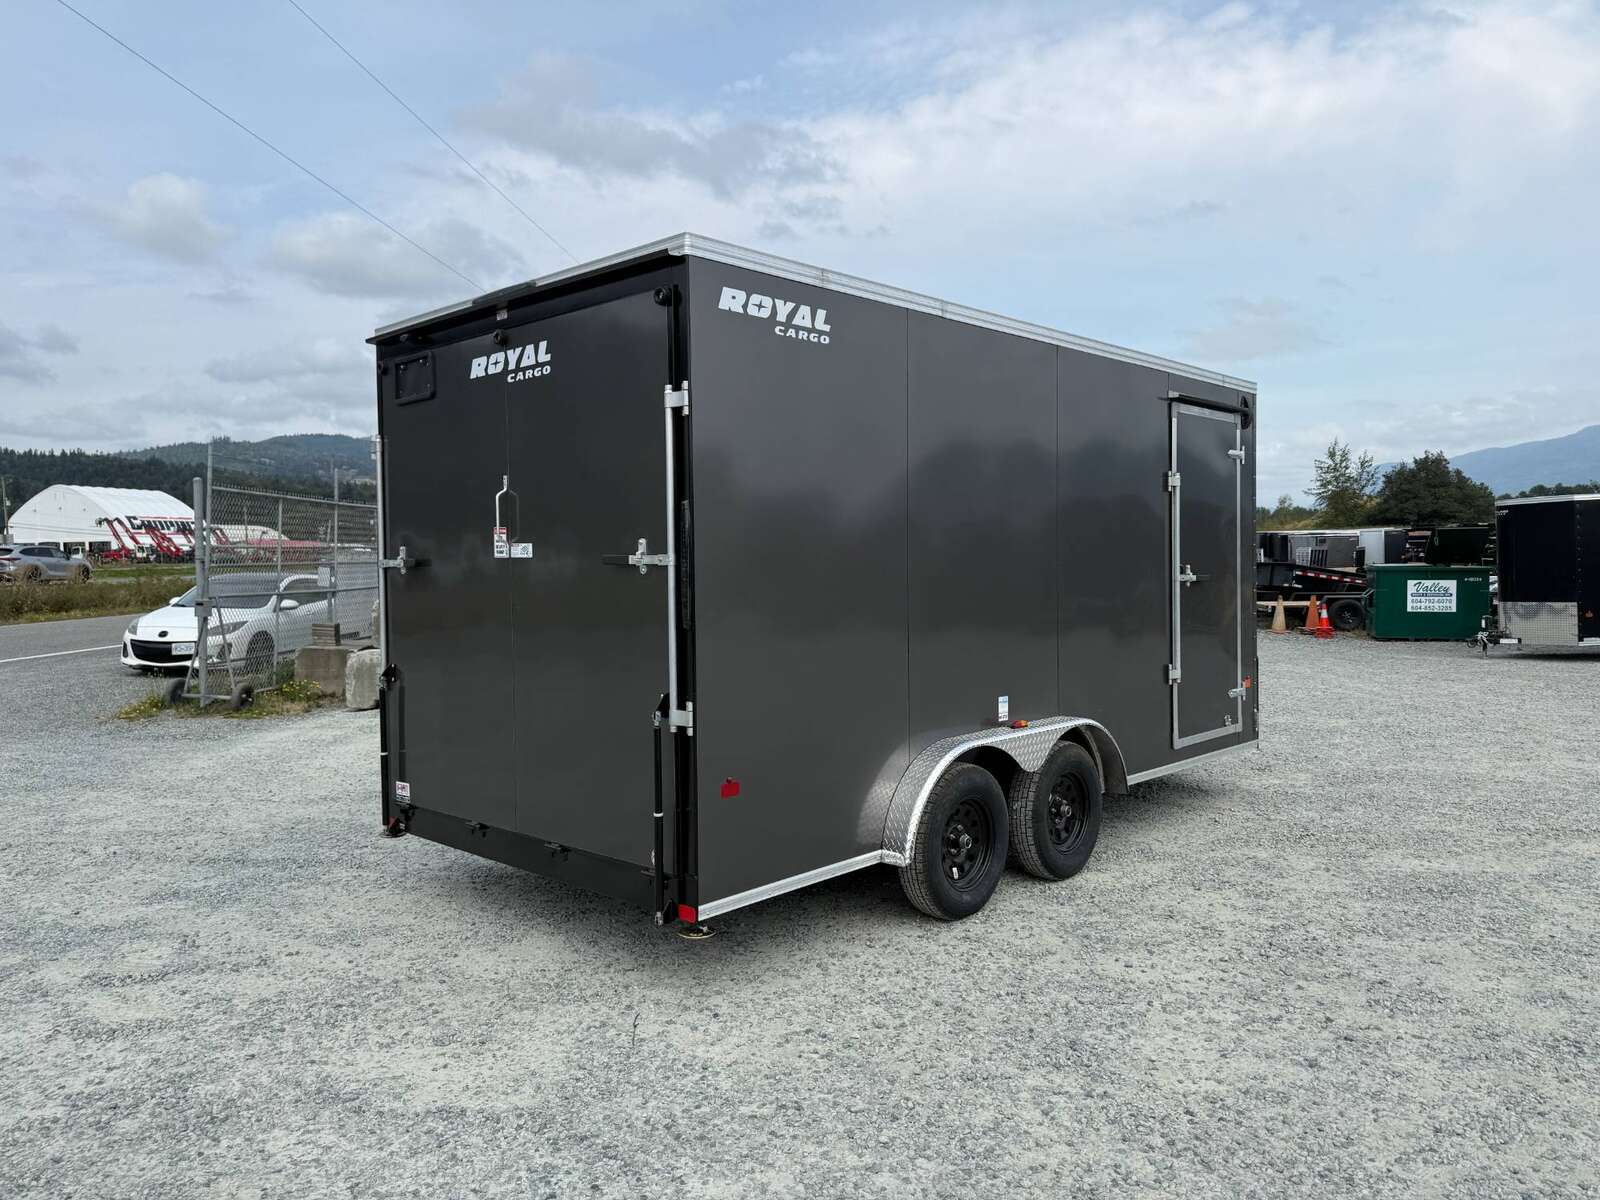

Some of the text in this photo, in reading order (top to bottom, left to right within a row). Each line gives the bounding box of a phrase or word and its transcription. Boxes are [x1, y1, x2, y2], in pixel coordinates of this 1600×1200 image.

[718, 286, 832, 332] ROYAL
[774, 326, 831, 345] CARGO
[470, 340, 552, 380] ROYAL
[507, 365, 552, 383] CARGO
[1414, 581, 1450, 593] Valley
